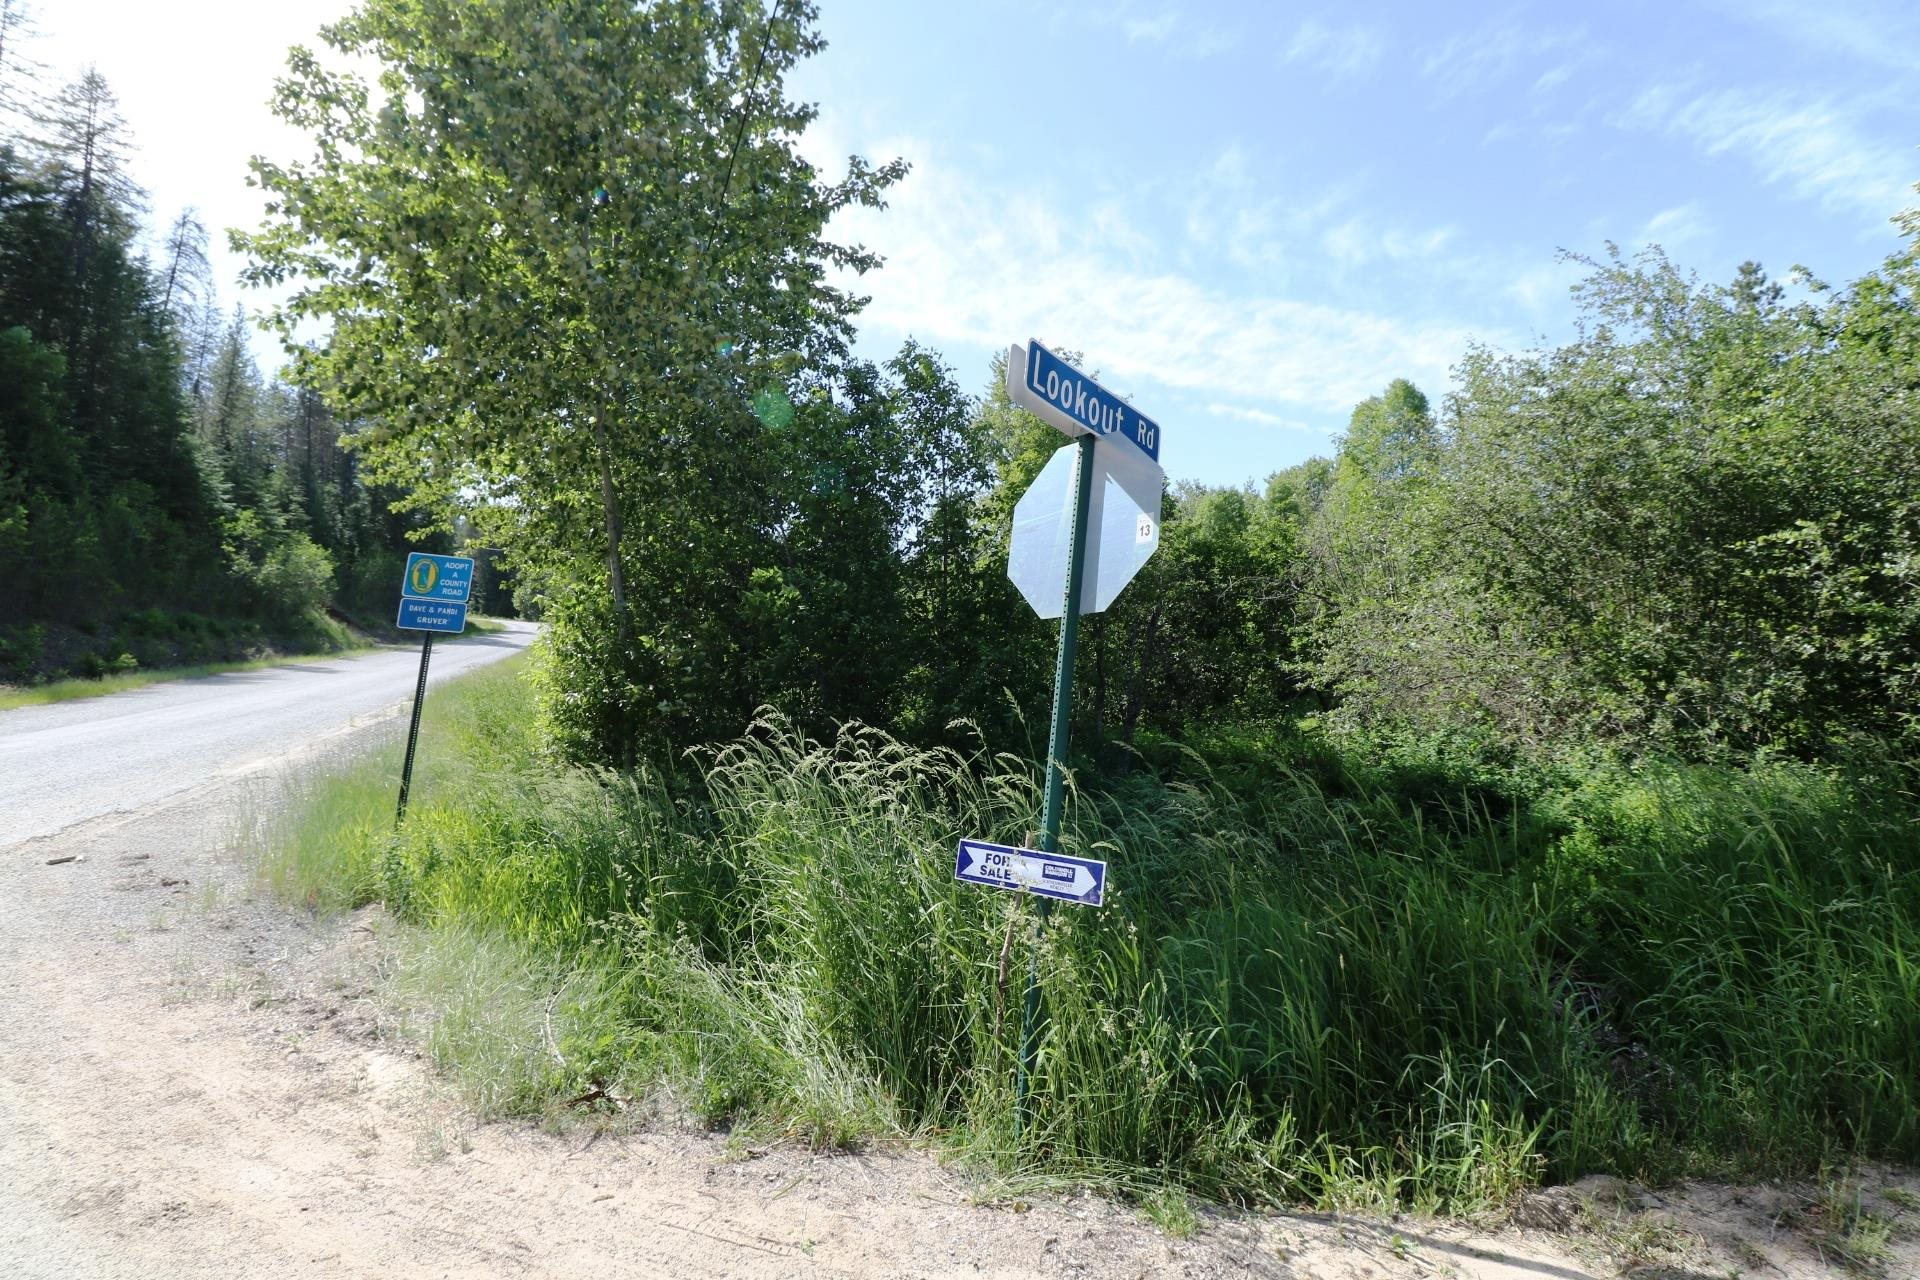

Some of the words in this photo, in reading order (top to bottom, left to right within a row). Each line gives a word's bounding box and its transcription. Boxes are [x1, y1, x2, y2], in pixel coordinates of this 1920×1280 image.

[1033, 350, 1124, 434] Lookout
[1137, 419, 1155, 450] Rd
[1139, 524, 1151, 537] 13
[444, 562, 469, 570] ADOPT
[440, 579, 468, 588] COUNTY
[442, 588, 463, 596] ROAD
[409, 605, 427, 613] DAVE
[416, 616, 449, 625] GRUVER
[985, 853, 1010, 867] FOR
[980, 865, 1011, 880] SALE
